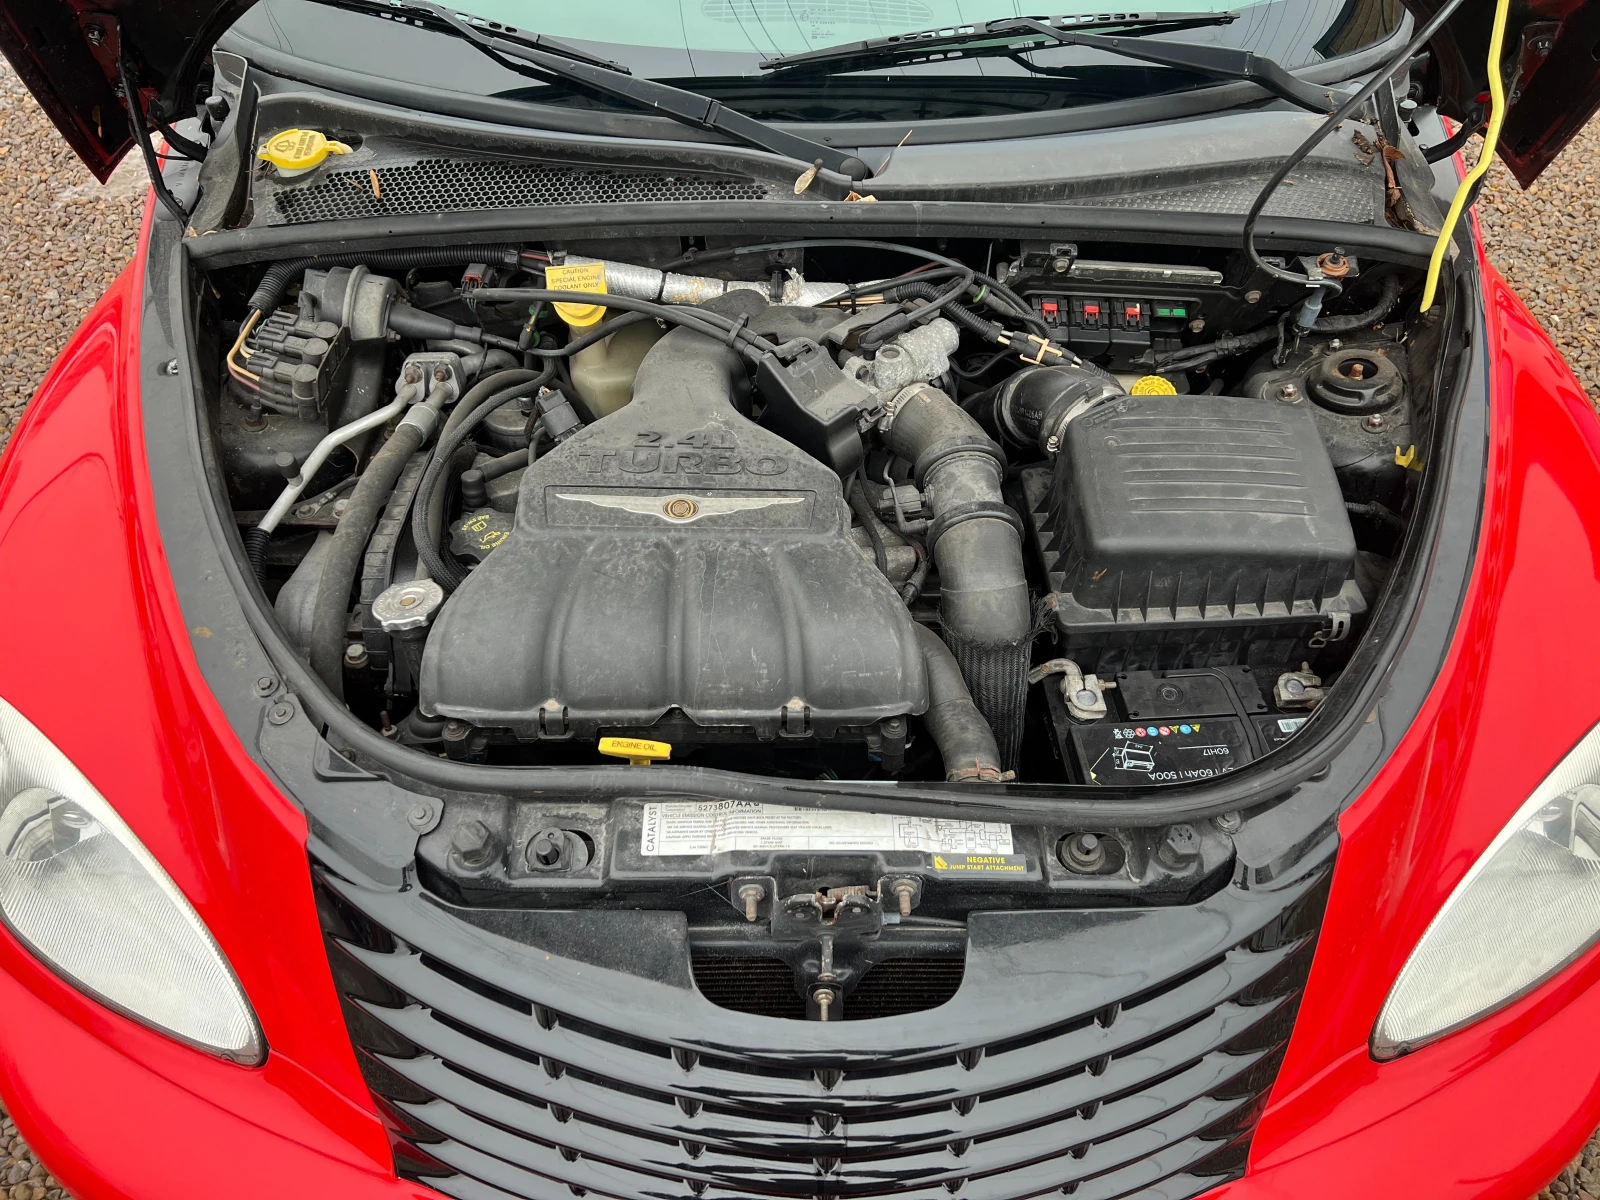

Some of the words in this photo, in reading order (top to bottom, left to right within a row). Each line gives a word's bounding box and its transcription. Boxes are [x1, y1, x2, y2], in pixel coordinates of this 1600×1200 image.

[562, 267, 589, 275] CAUTION
[577, 274, 602, 282] ENGINE
[553, 283, 582, 291] COOLANT
[633, 430, 735, 450] 2.4L
[578, 450, 789, 476] TURBO
[611, 740, 642, 750] ENGINE
[643, 743, 657, 751] OIL
[1147, 771, 1178, 781] 500A
[1185, 767, 1214, 778] 60Ah
[646, 806, 658, 852] CATALYST
[966, 856, 1006, 864] NEGATIVE
